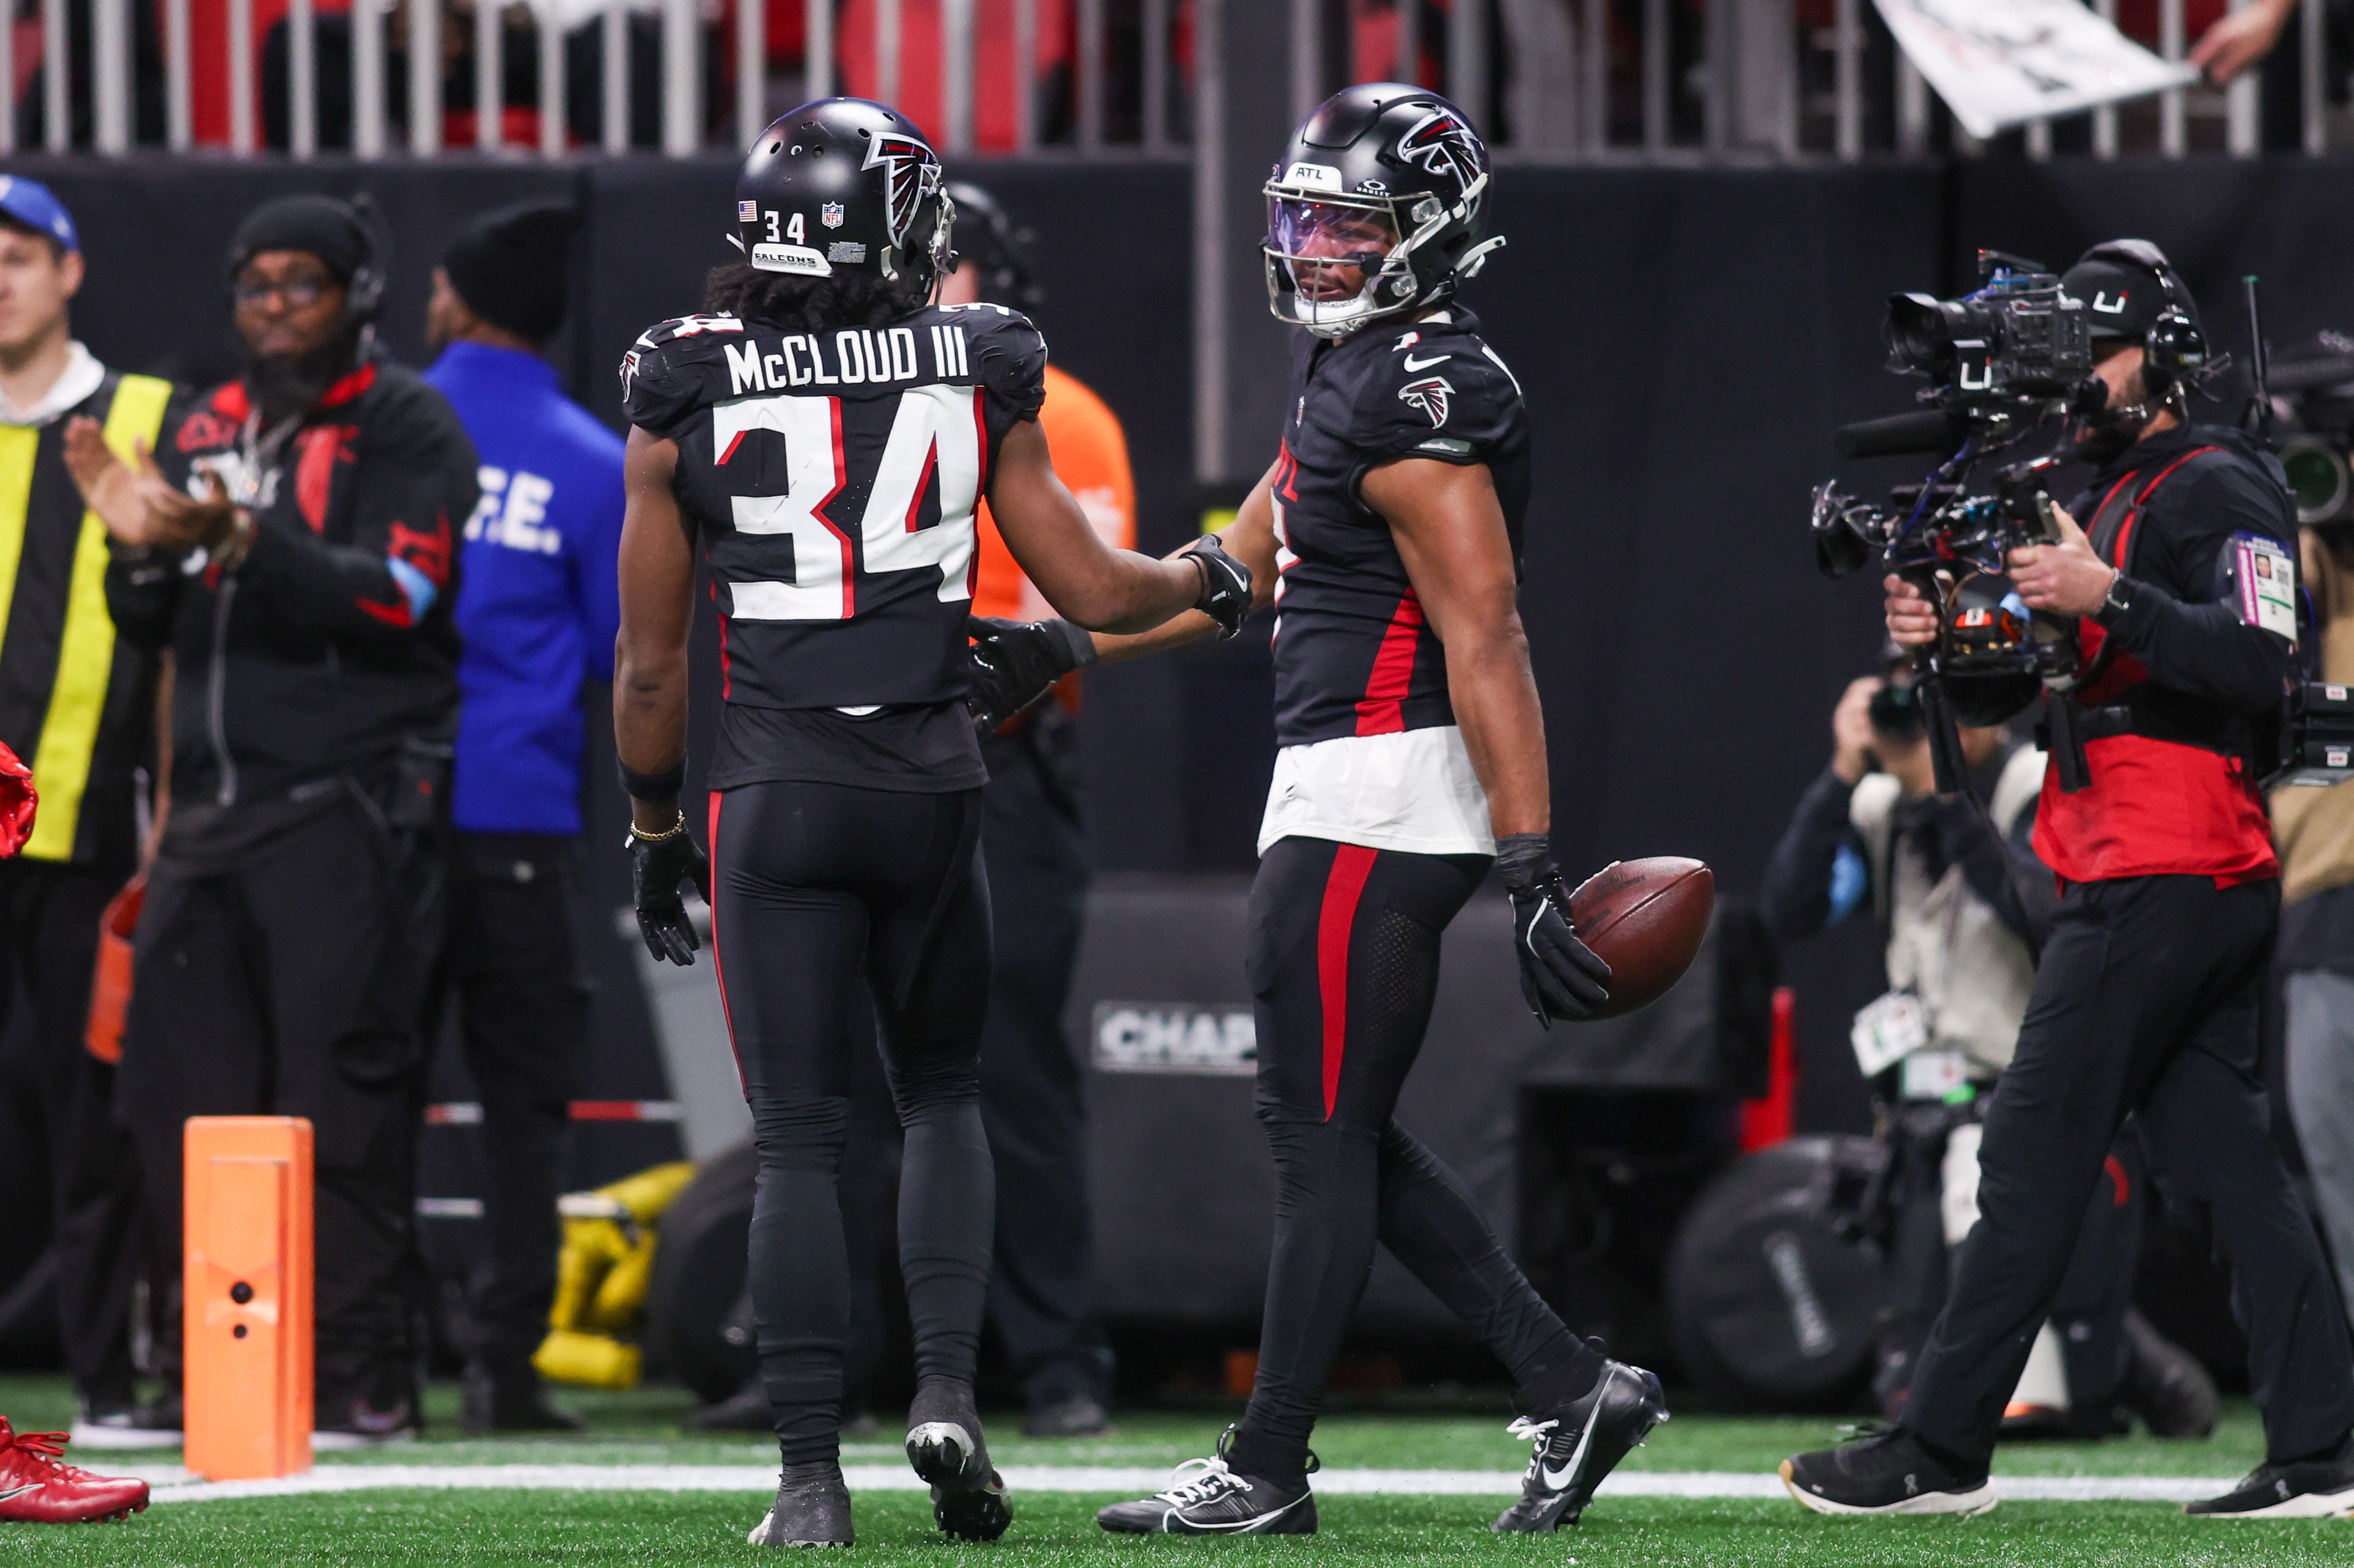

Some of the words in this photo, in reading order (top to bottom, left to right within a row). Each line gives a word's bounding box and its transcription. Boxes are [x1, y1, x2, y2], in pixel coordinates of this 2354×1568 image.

[1295, 166, 1323, 180] ATL
[764, 210, 807, 245] 34
[825, 213, 841, 224] NFL
[754, 252, 817, 265] FALCONS
[724, 328, 918, 395] McCLOUD
[931, 325, 970, 377] III
[713, 385, 989, 620] 34
